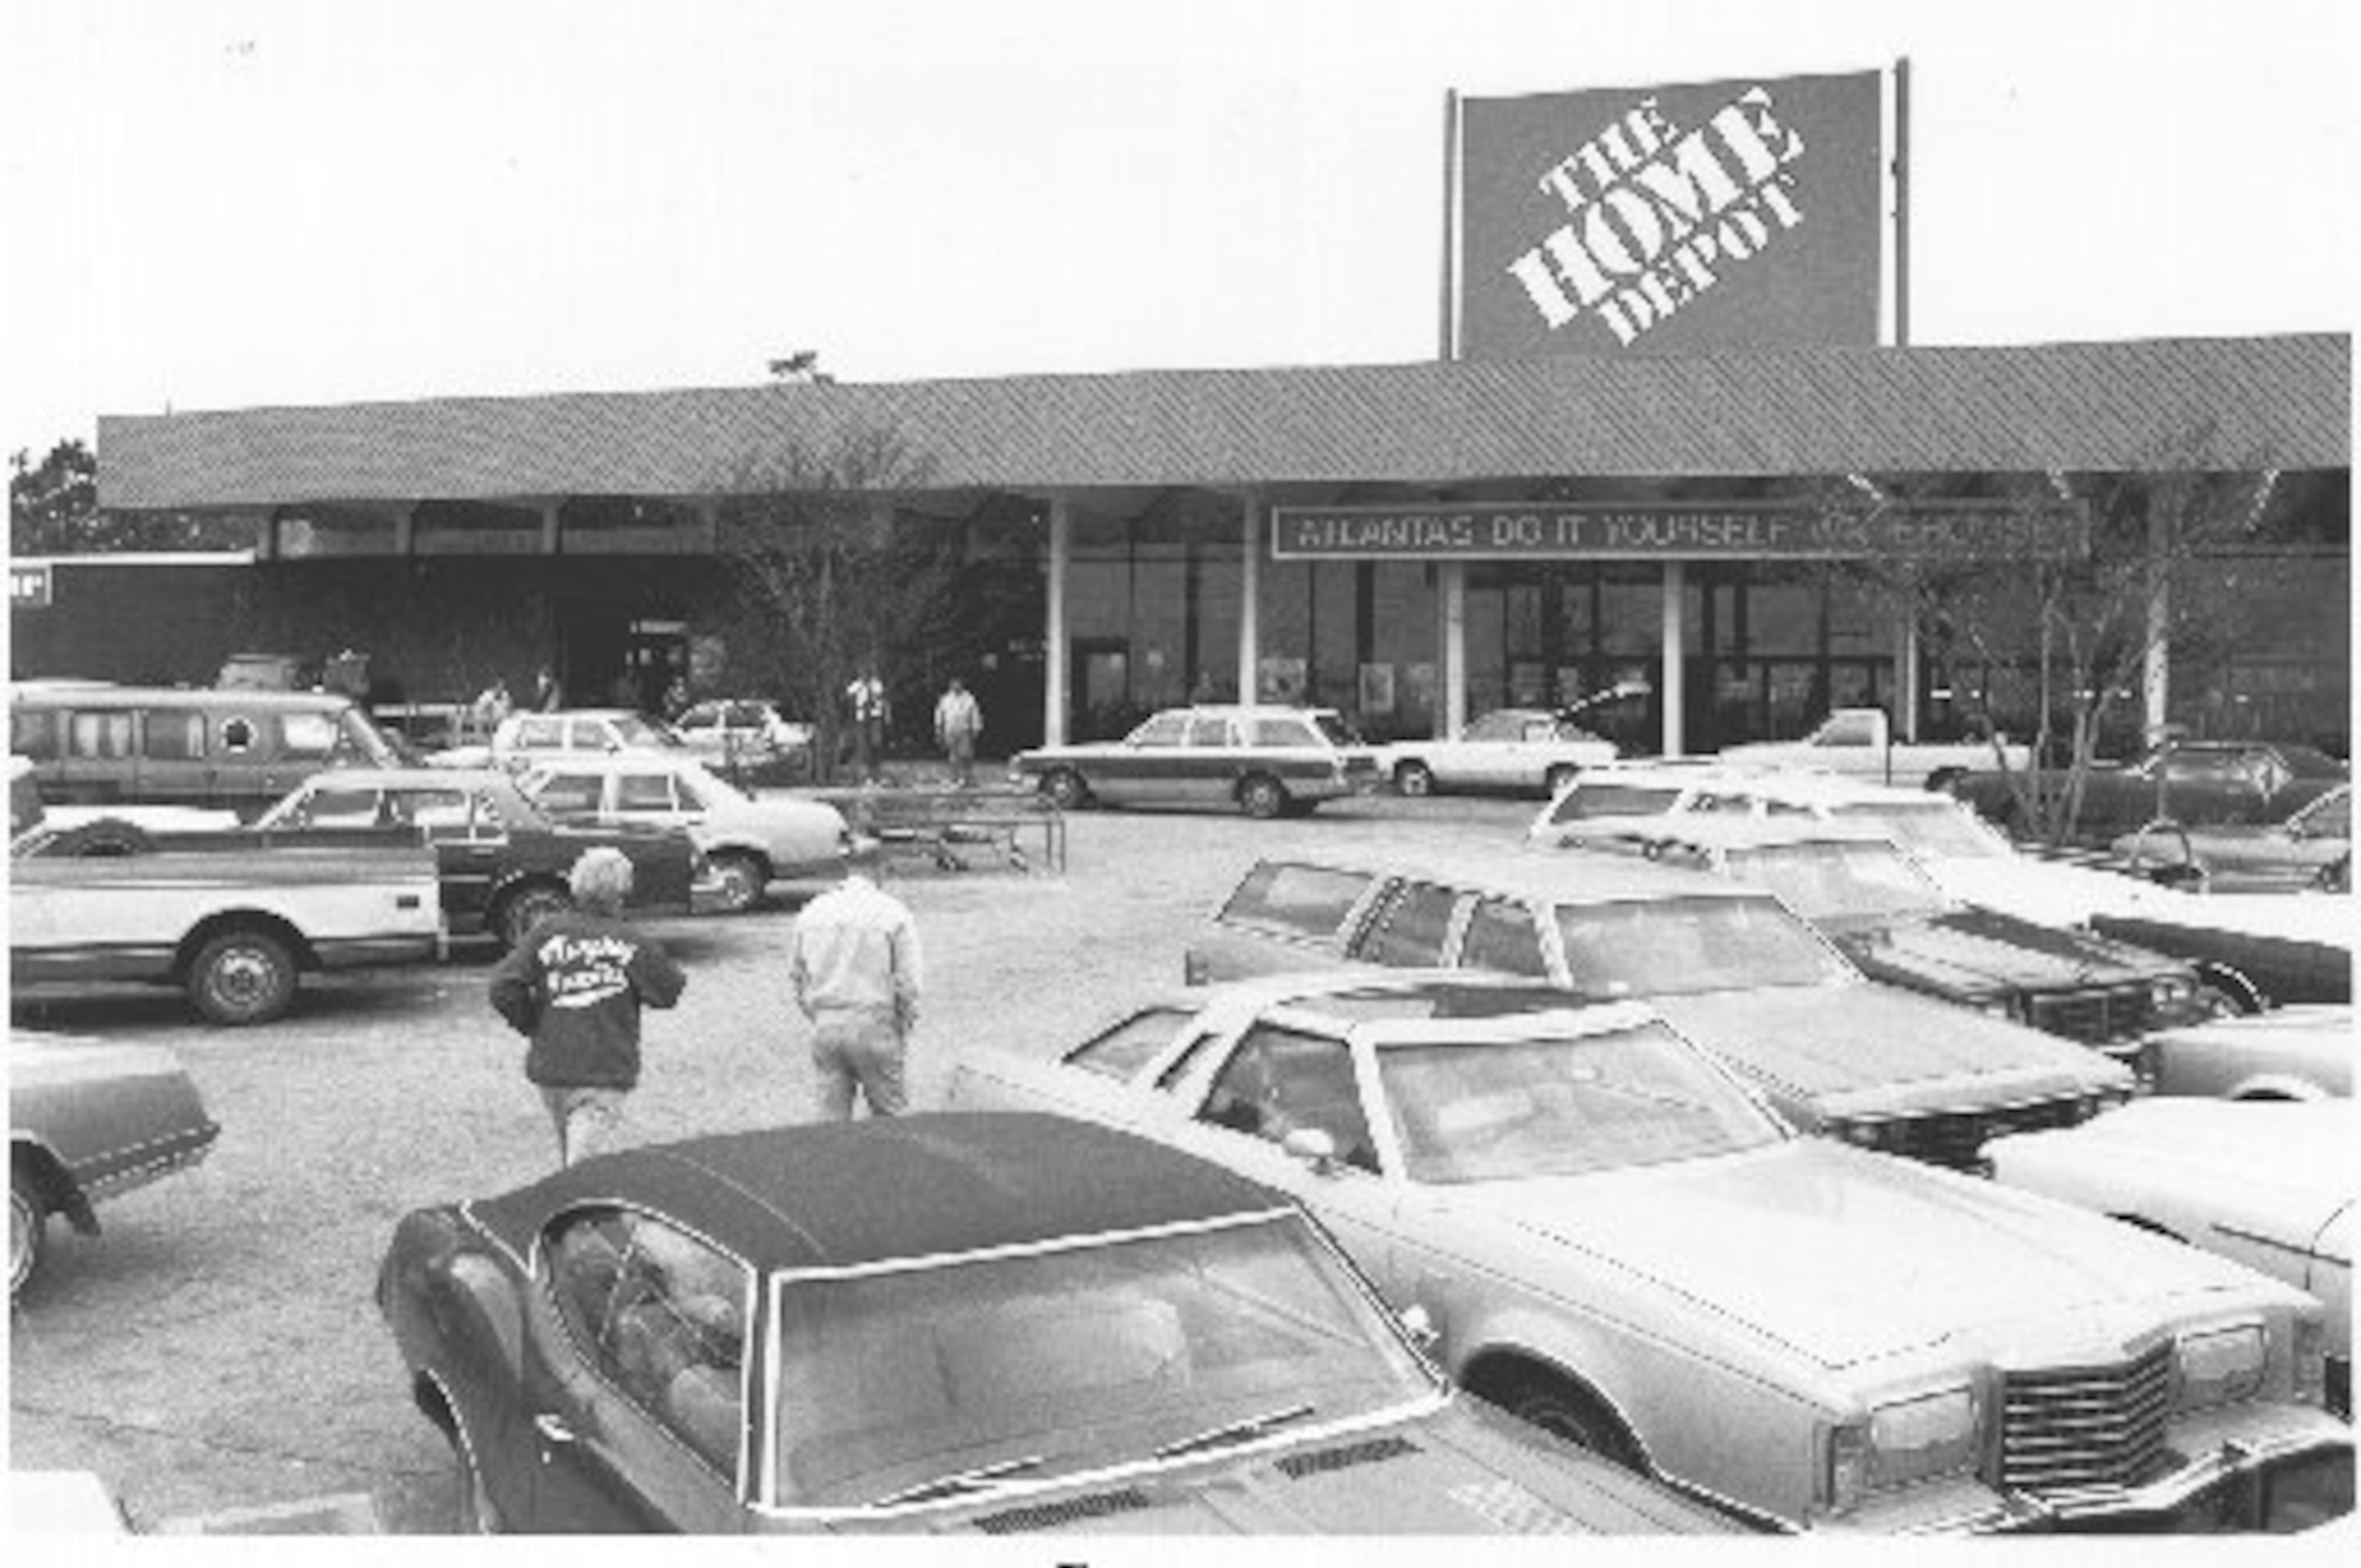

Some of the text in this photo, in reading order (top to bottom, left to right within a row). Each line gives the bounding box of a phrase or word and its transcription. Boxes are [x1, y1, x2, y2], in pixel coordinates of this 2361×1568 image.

[1506, 85, 1805, 331] HOME
[1538, 96, 1680, 213] THE
[1598, 171, 1805, 347] DEPOT
[1492, 515, 1542, 547] DO
[1556, 515, 1589, 545] IT
[1602, 514, 1789, 546] YOURSELF
